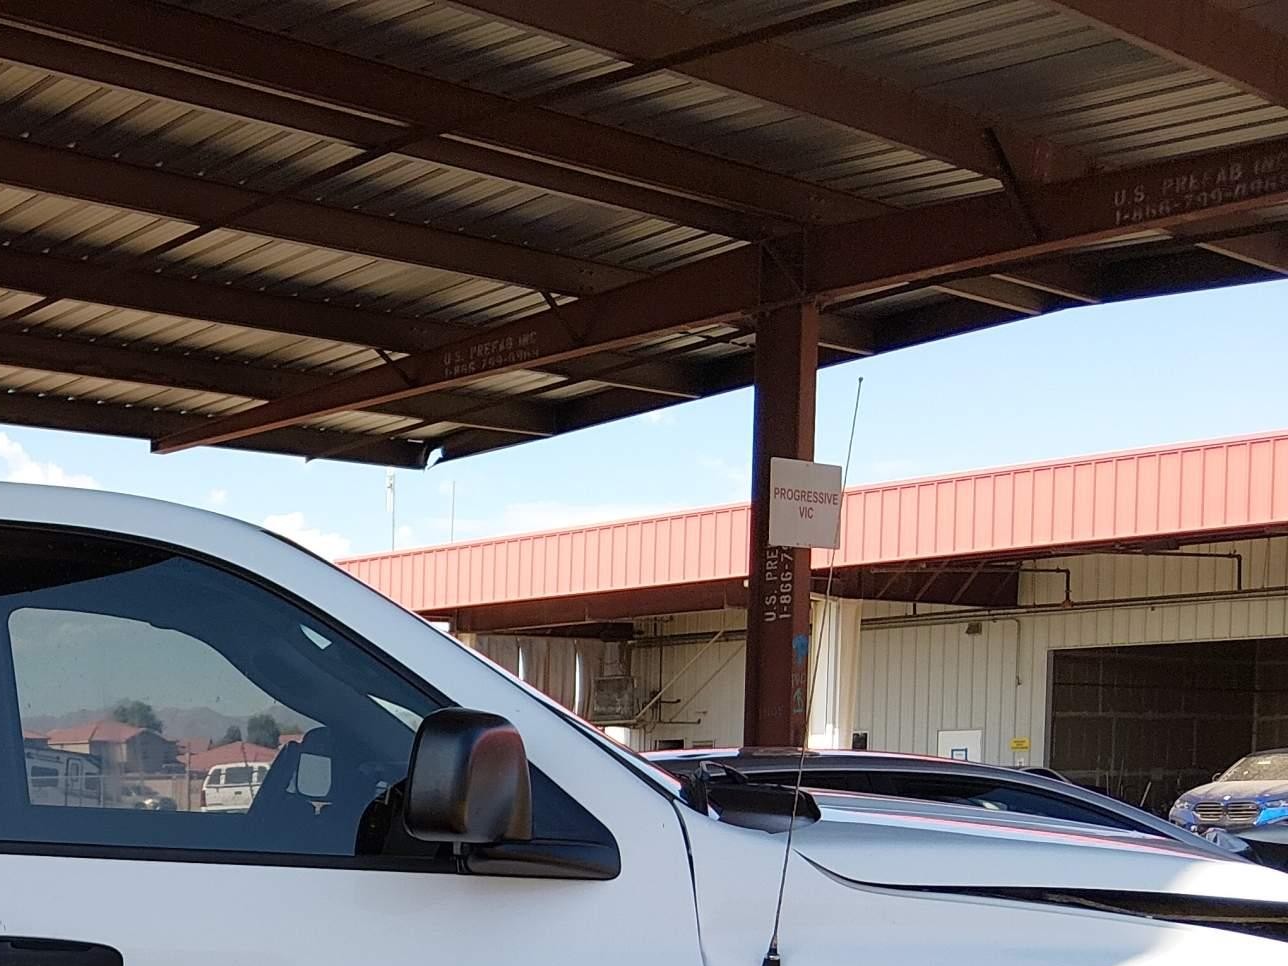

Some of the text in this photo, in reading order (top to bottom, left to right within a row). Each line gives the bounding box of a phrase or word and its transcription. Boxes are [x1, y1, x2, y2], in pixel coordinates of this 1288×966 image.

[773, 487, 839, 506] PROGRESSIVE
[799, 506, 815, 520] VIC
[764, 589, 778, 622] U.S.
